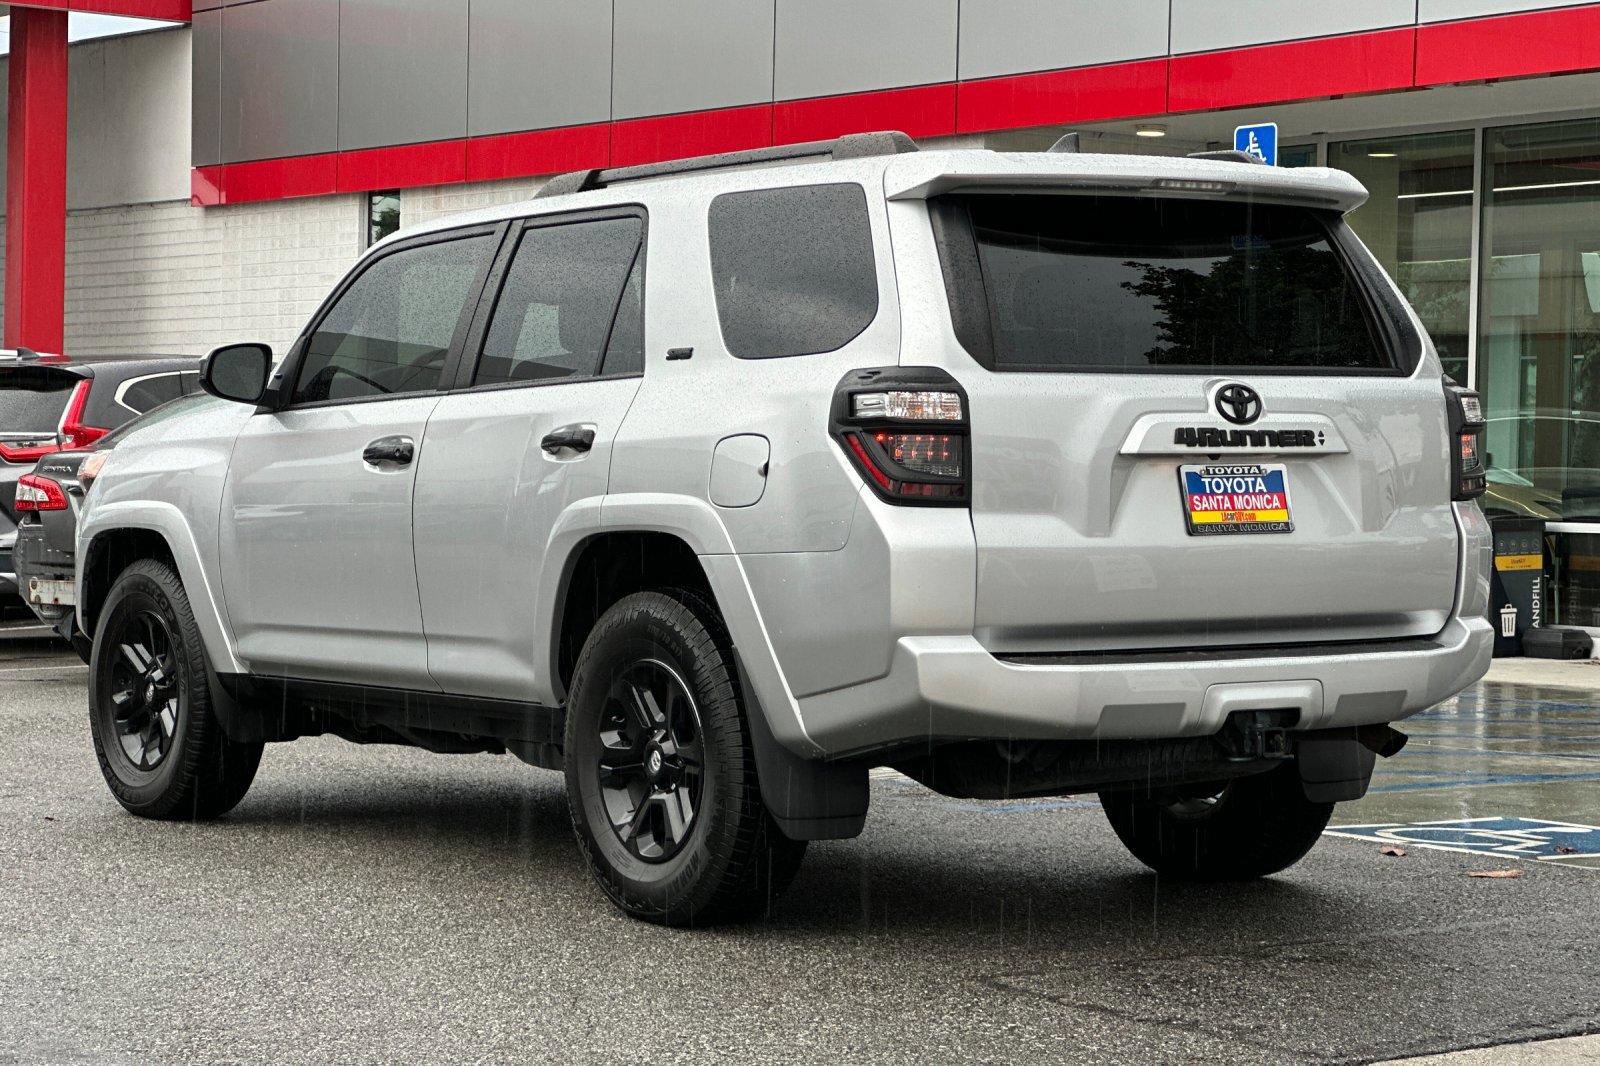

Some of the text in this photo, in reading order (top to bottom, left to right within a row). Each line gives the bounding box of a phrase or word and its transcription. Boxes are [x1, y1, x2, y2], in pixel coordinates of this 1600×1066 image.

[1207, 466, 1259, 474] TOYOTA
[1201, 477, 1267, 494] TOYOTA
[1193, 494, 1281, 511] SANTA MONICA
[1197, 522, 1288, 533] SANTA MONICA
[1532, 577, 1540, 628] ANDFILL
